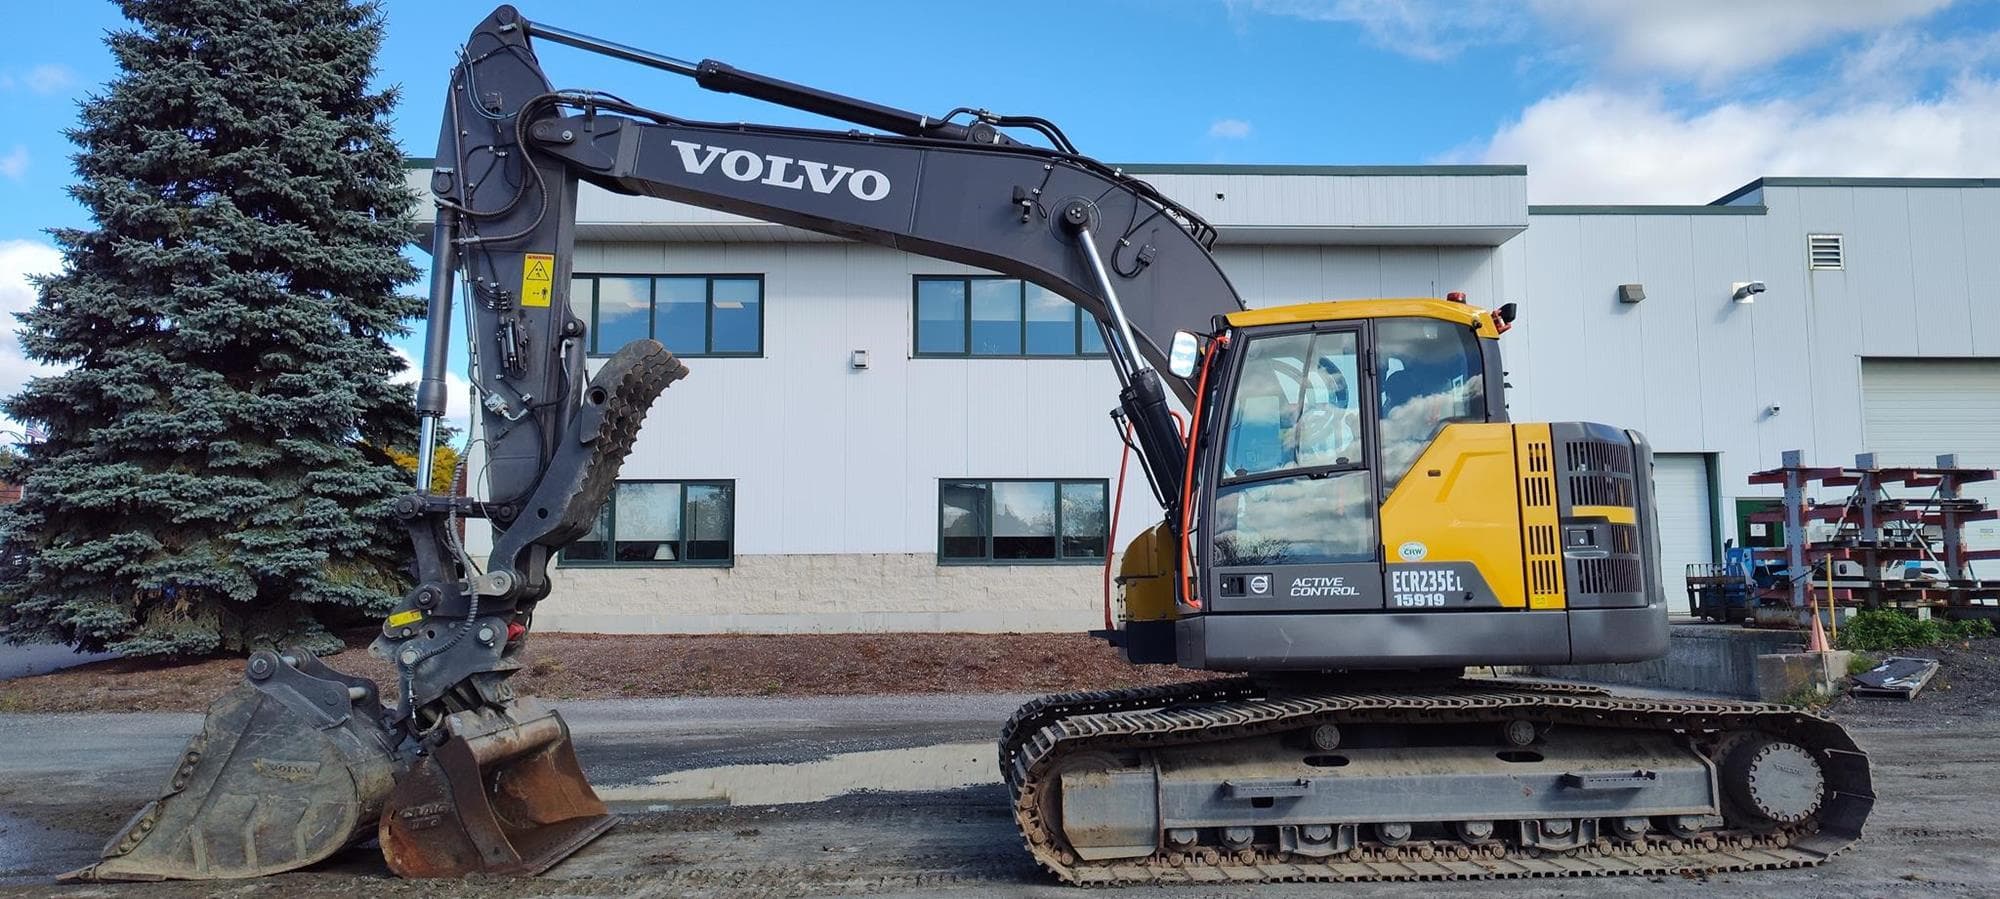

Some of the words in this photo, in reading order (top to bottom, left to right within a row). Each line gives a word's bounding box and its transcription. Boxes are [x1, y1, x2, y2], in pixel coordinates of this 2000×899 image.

[671, 140, 890, 201] VOLVO
[1403, 548, 1423, 556] CRW
[1292, 577, 1344, 587] ACTIVE
[1290, 586, 1360, 596] CONTROL
[1394, 593, 1445, 606] 15919
